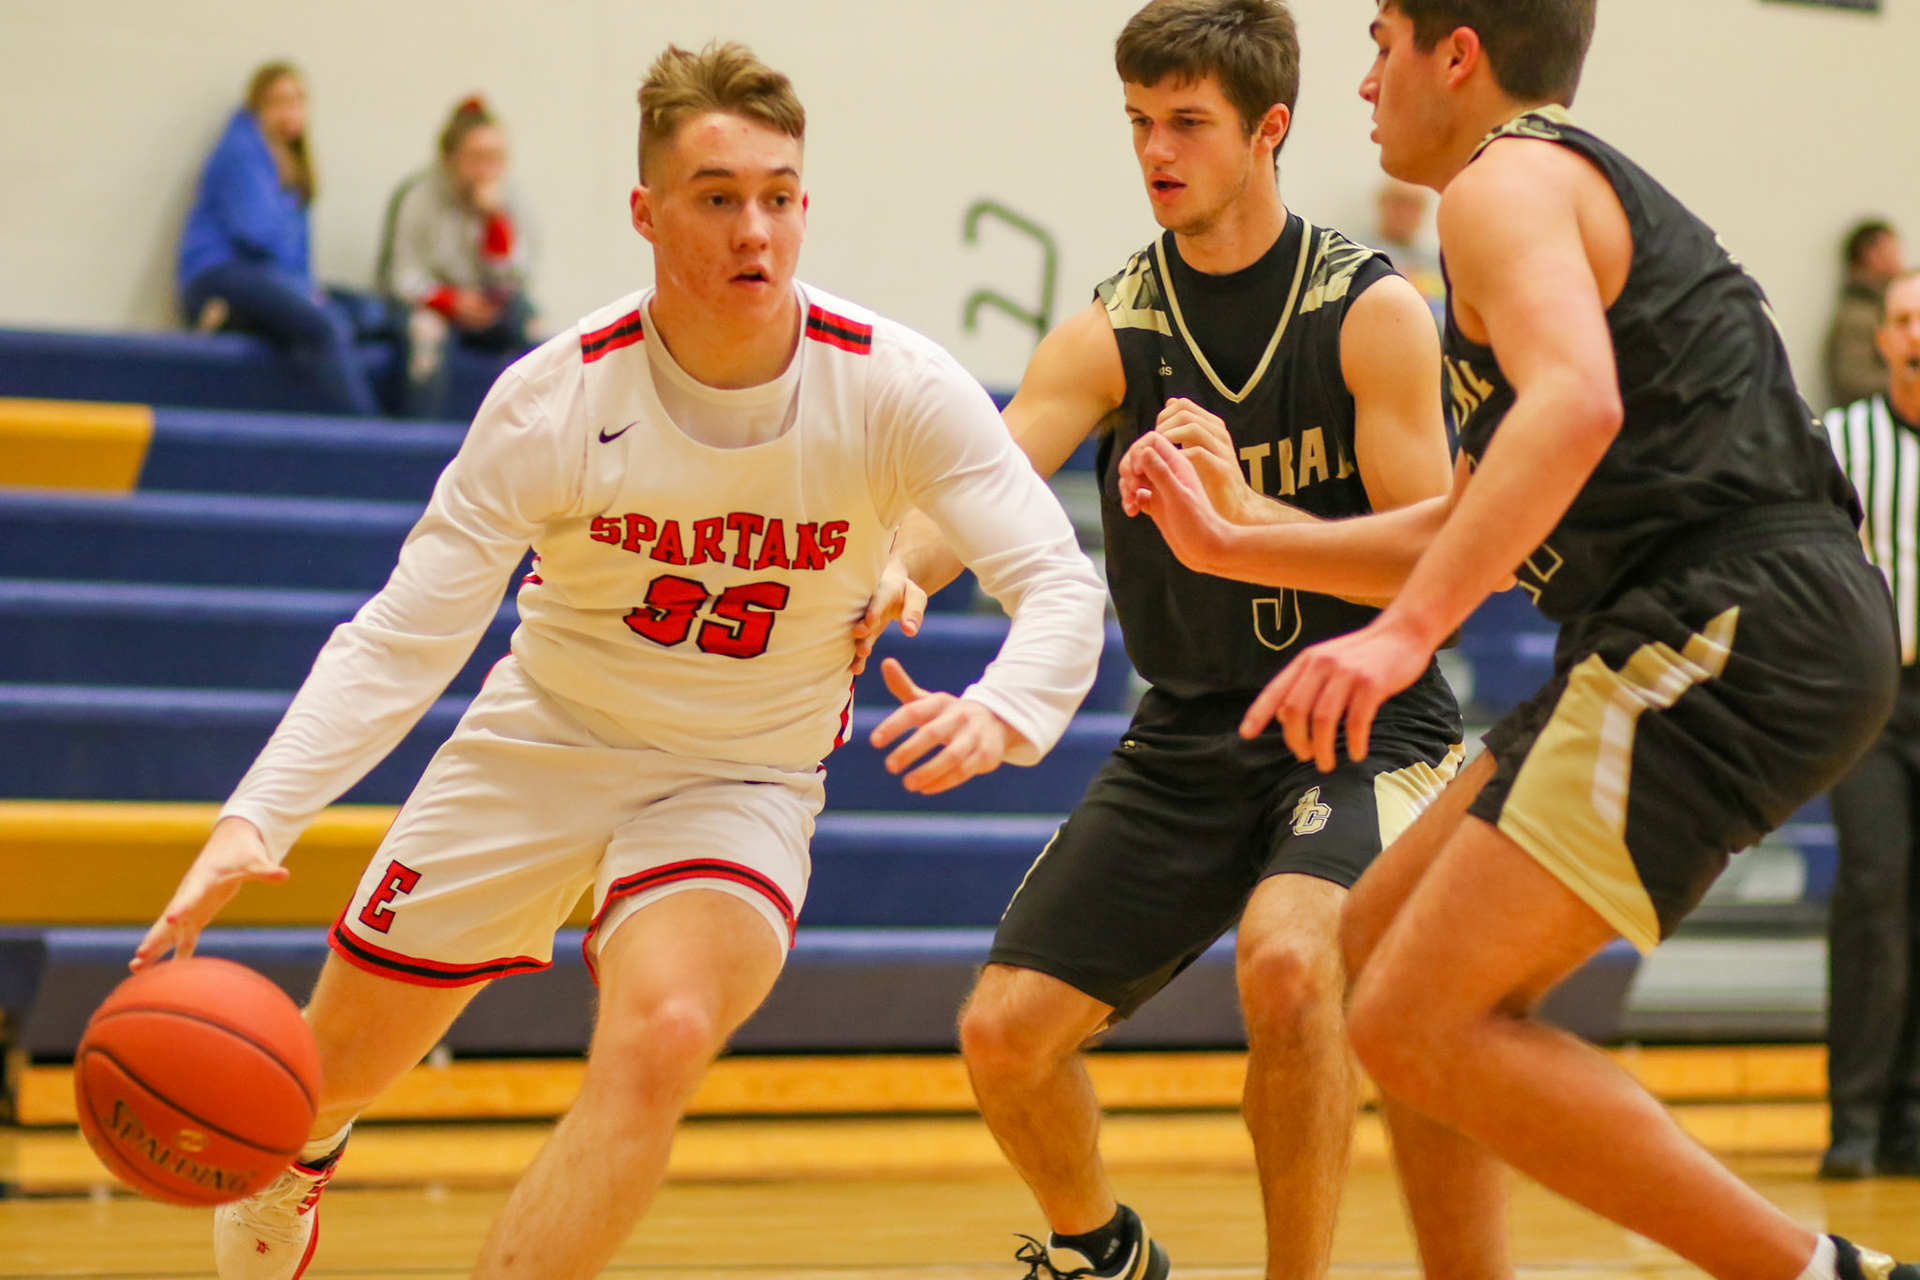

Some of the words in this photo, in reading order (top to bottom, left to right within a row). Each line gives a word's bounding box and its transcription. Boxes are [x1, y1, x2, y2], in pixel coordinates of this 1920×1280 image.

[590, 512, 849, 570] SPARTANS
[622, 573, 790, 659] 35
[358, 859, 422, 934] E
[105, 1099, 253, 1193] SPALDING
